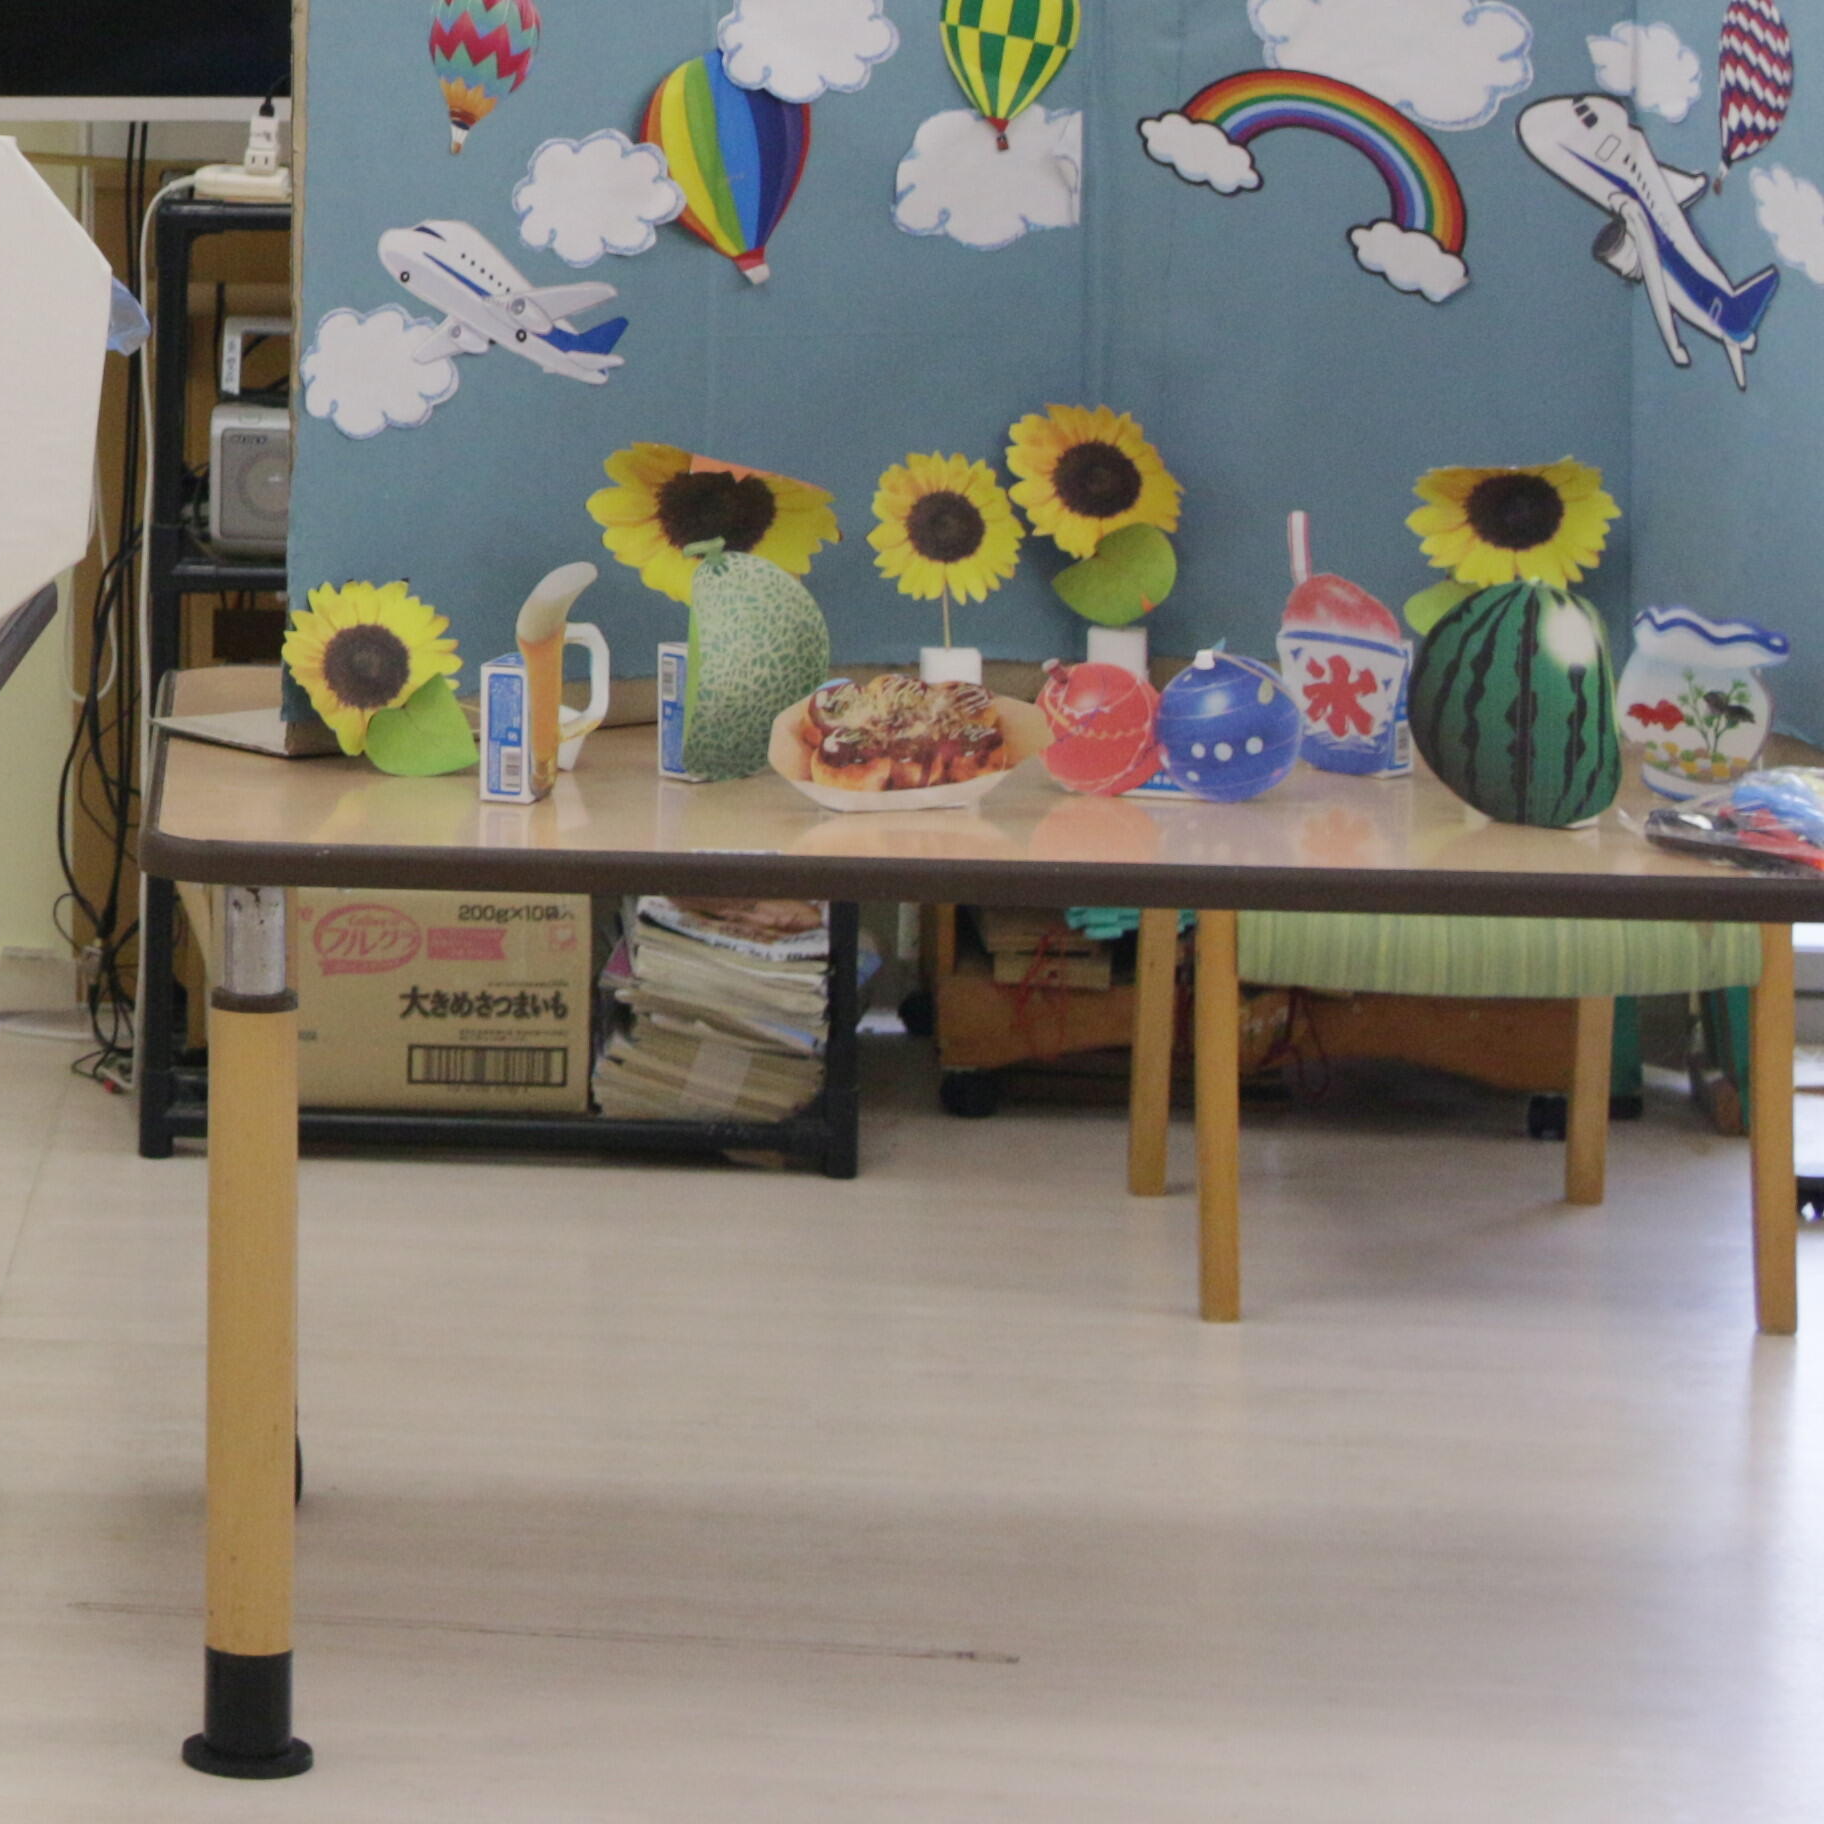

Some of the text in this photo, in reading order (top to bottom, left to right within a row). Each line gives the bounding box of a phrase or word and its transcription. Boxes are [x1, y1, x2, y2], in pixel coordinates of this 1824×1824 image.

[1301, 653, 1378, 738] 氷
[399, 985, 569, 1020] 大きめさつまいも
